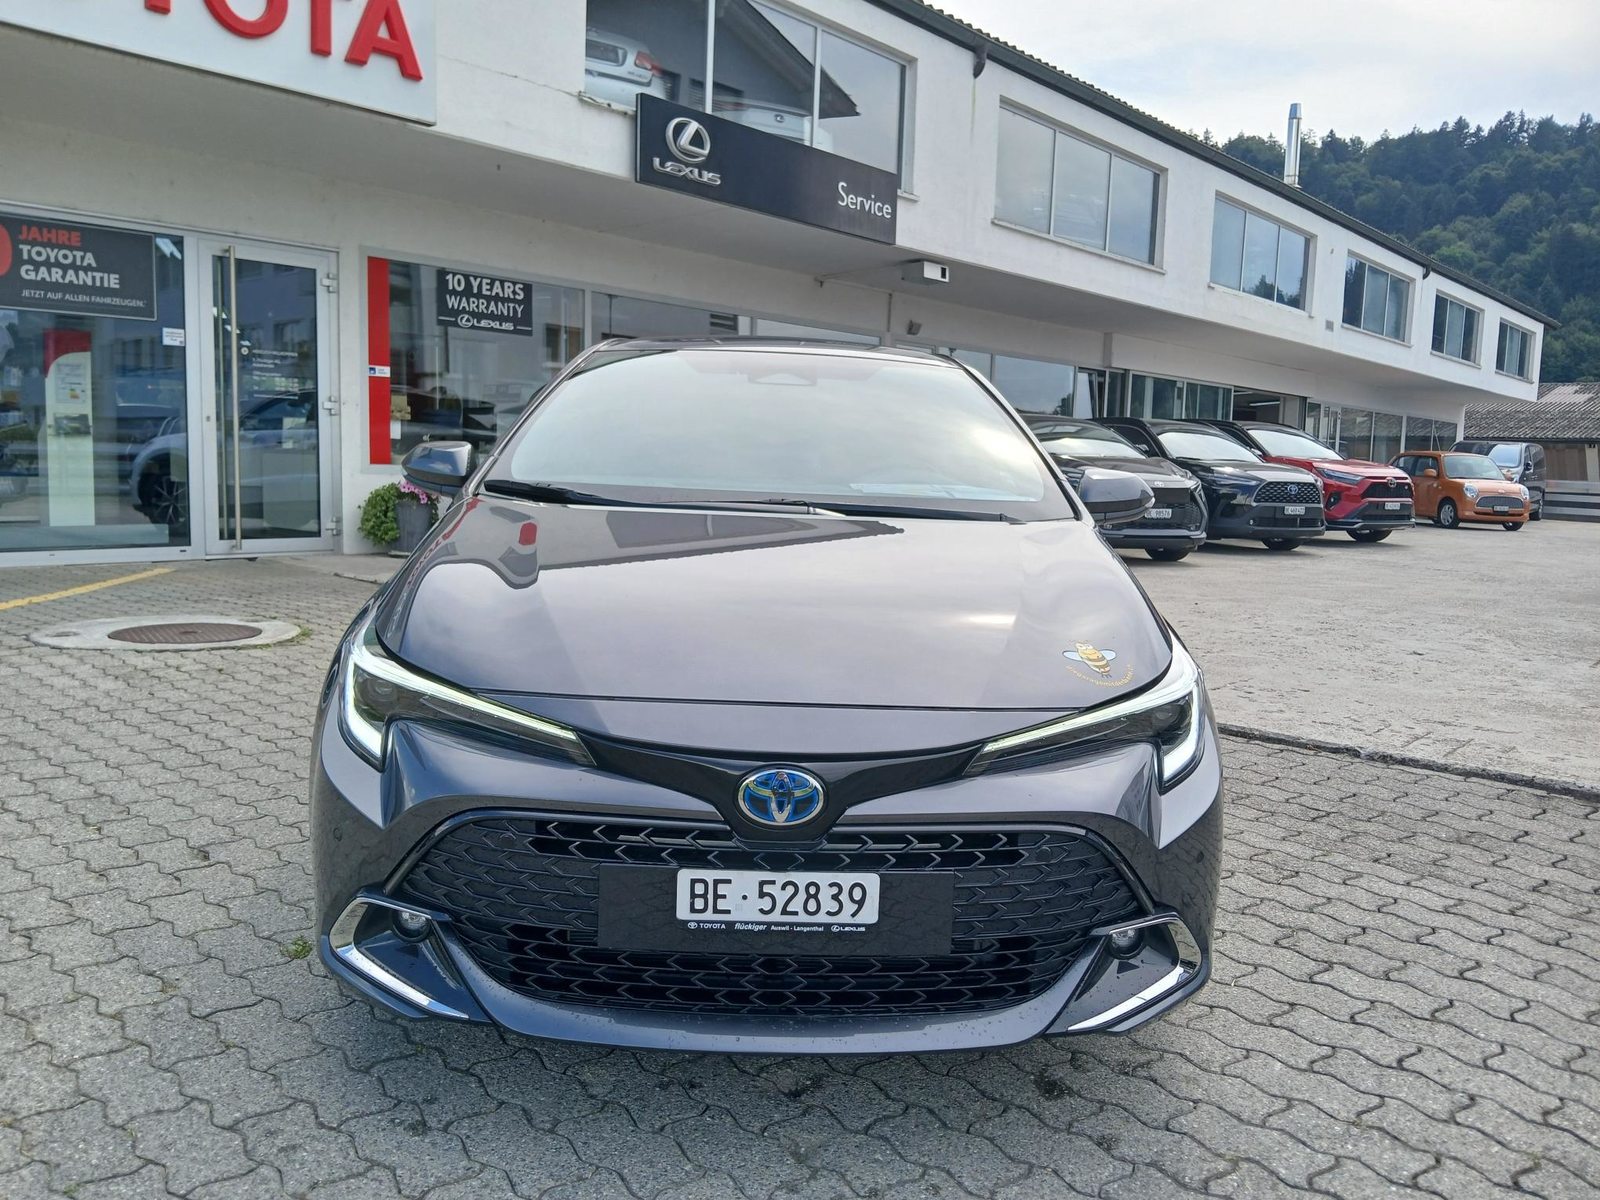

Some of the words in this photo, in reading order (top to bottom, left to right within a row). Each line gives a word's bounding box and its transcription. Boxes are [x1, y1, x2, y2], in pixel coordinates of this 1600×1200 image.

[652, 157, 722, 186] LEXUS
[837, 181, 893, 219] Service
[19, 224, 82, 247] JAHRE
[18, 244, 97, 267] TOYOTA
[20, 265, 121, 289] GARANTIE
[445, 273, 466, 292] 10
[469, 276, 525, 300] YEARS
[21, 289, 45, 299] JETZT
[47, 291, 63, 300] AUF
[65, 293, 90, 303] ALLEN
[445, 293, 525, 318] WARRANTY
[473, 318, 515, 331] LEXUS
[689, 877, 733, 915] BE
[757, 879, 868, 919] 52839
[699, 922, 726, 930] TOYOTA
